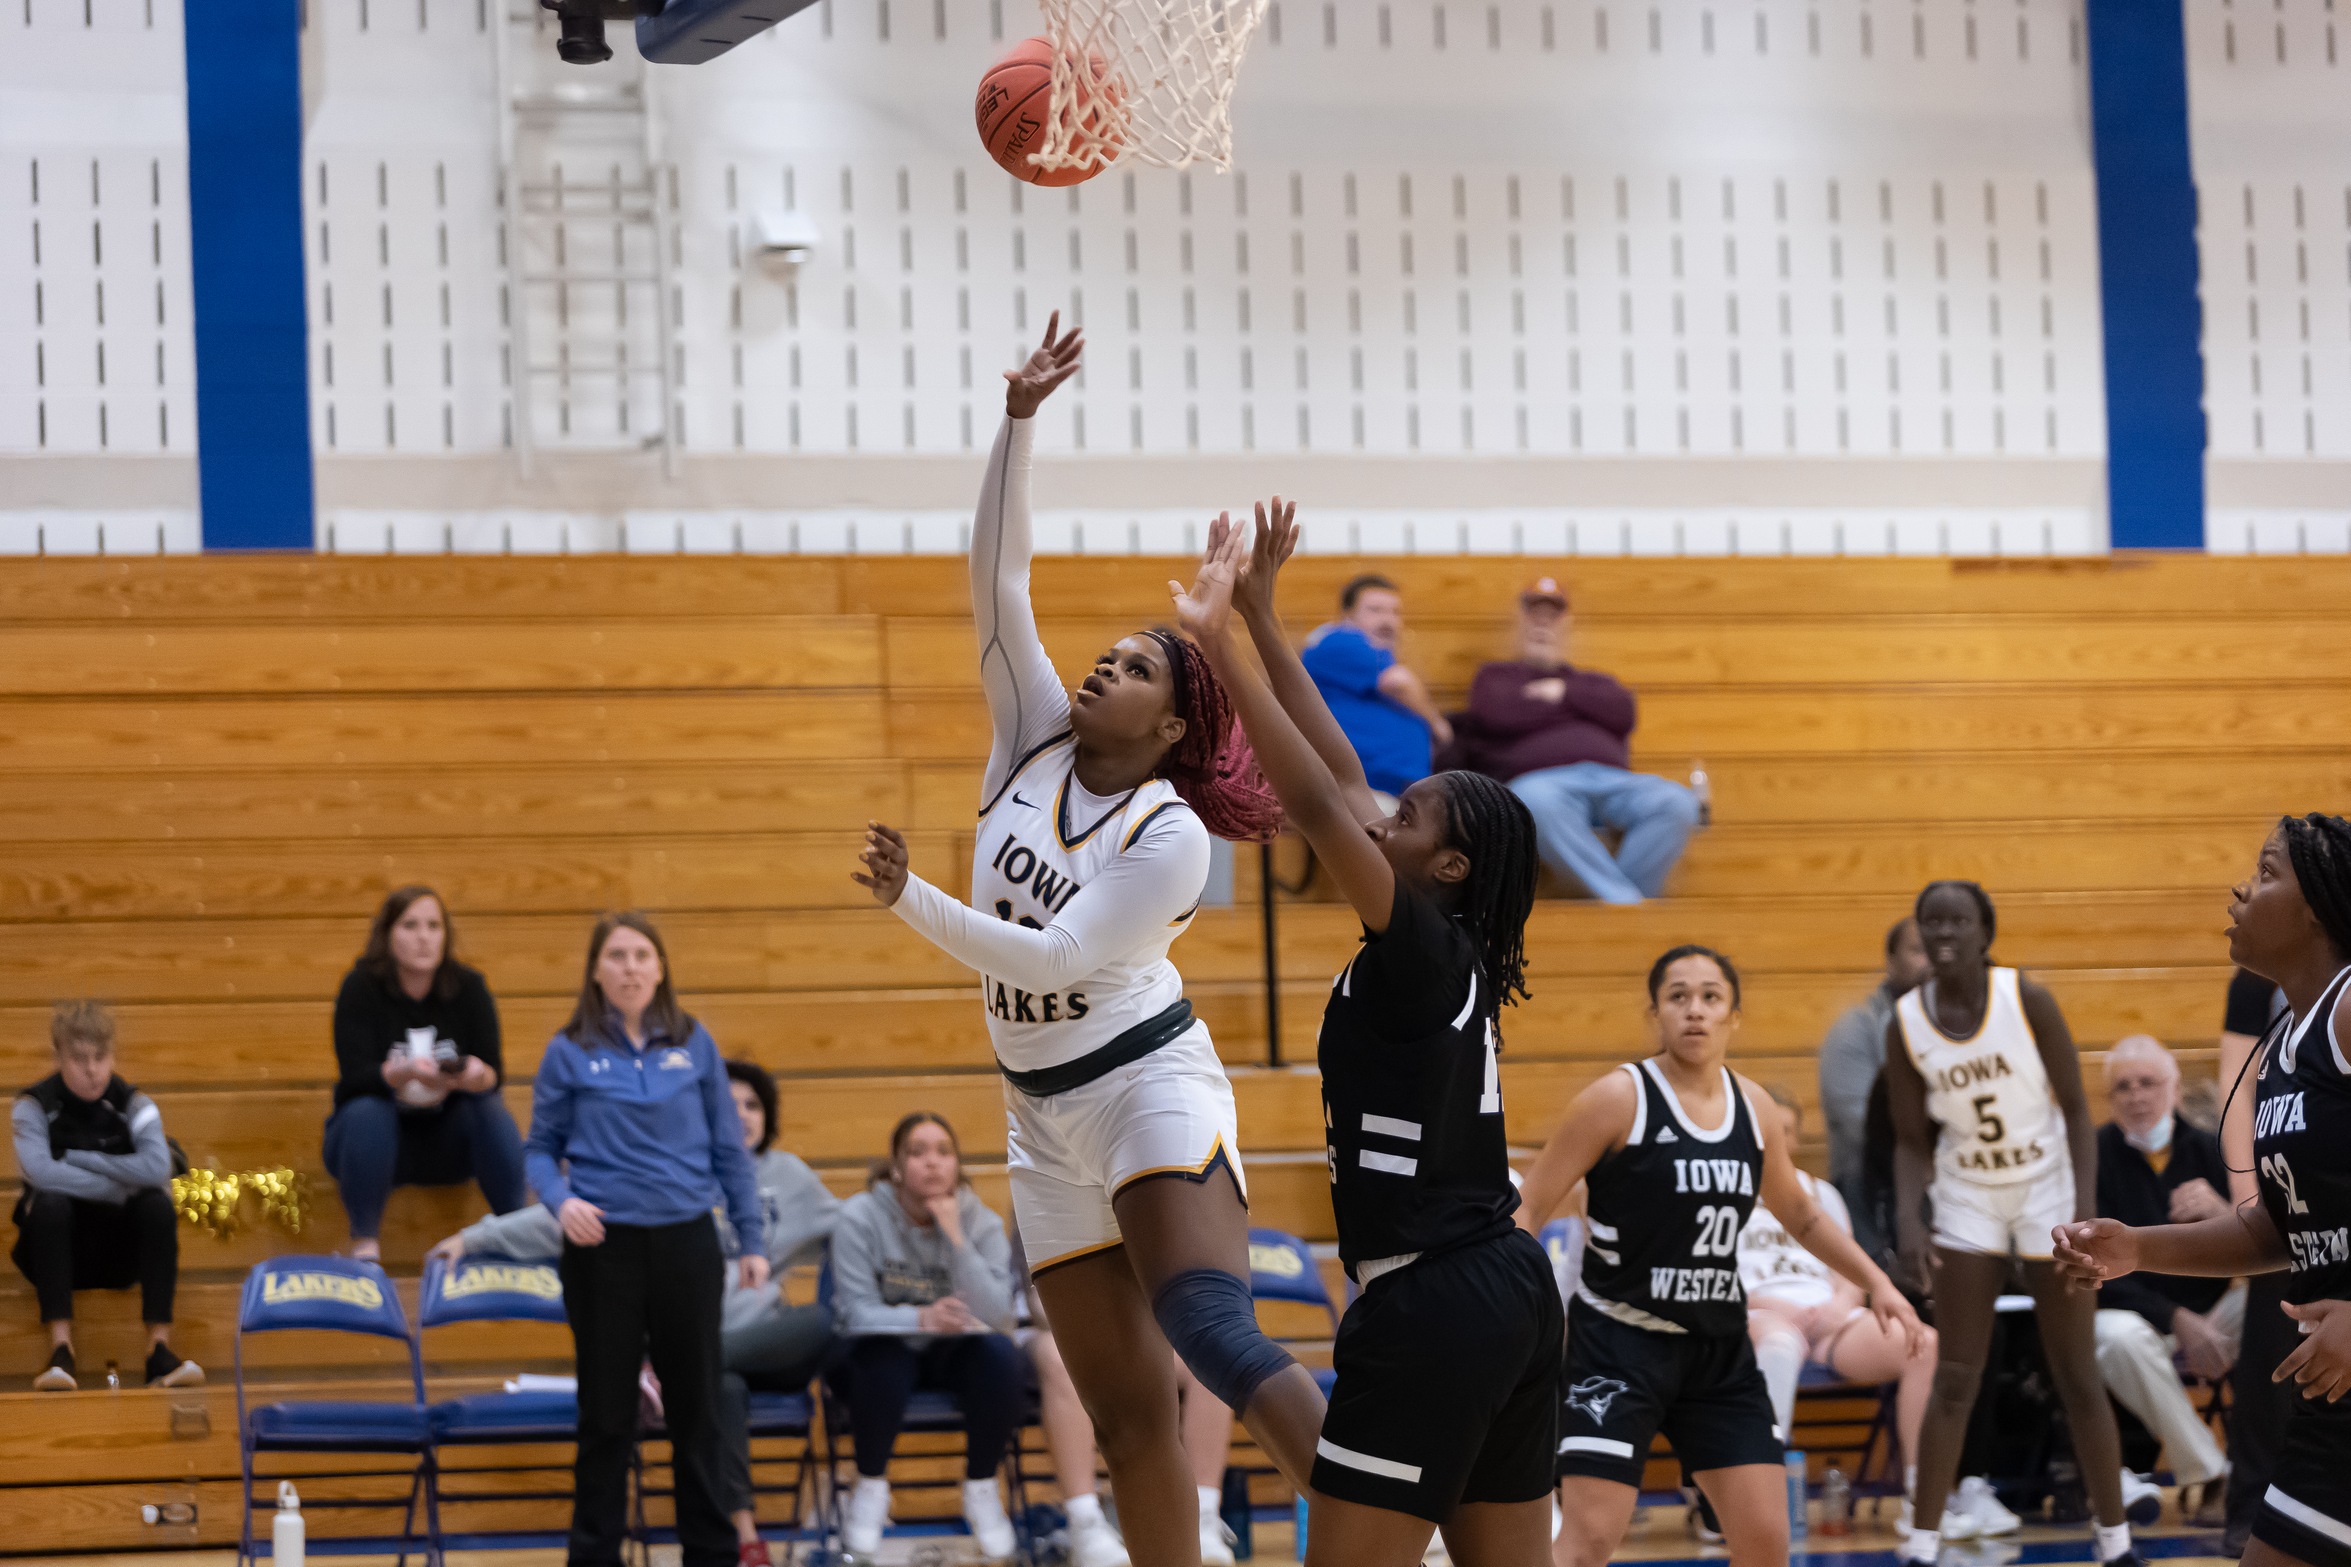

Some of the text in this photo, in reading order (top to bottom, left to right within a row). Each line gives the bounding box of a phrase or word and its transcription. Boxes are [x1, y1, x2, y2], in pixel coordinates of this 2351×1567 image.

[985, 974, 1089, 1023] LAKES
[1480, 1017, 1504, 1113] 1
[1938, 1053, 2011, 1092] IOWA
[1974, 1095, 2005, 1142] 5
[2254, 1091, 2306, 1140] IOWA
[1674, 1159, 1753, 1196] IOWA
[1957, 1139, 2044, 1170] LAKES
[1692, 1205, 1739, 1257] 20
[264, 1271, 383, 1309] LAKERS
